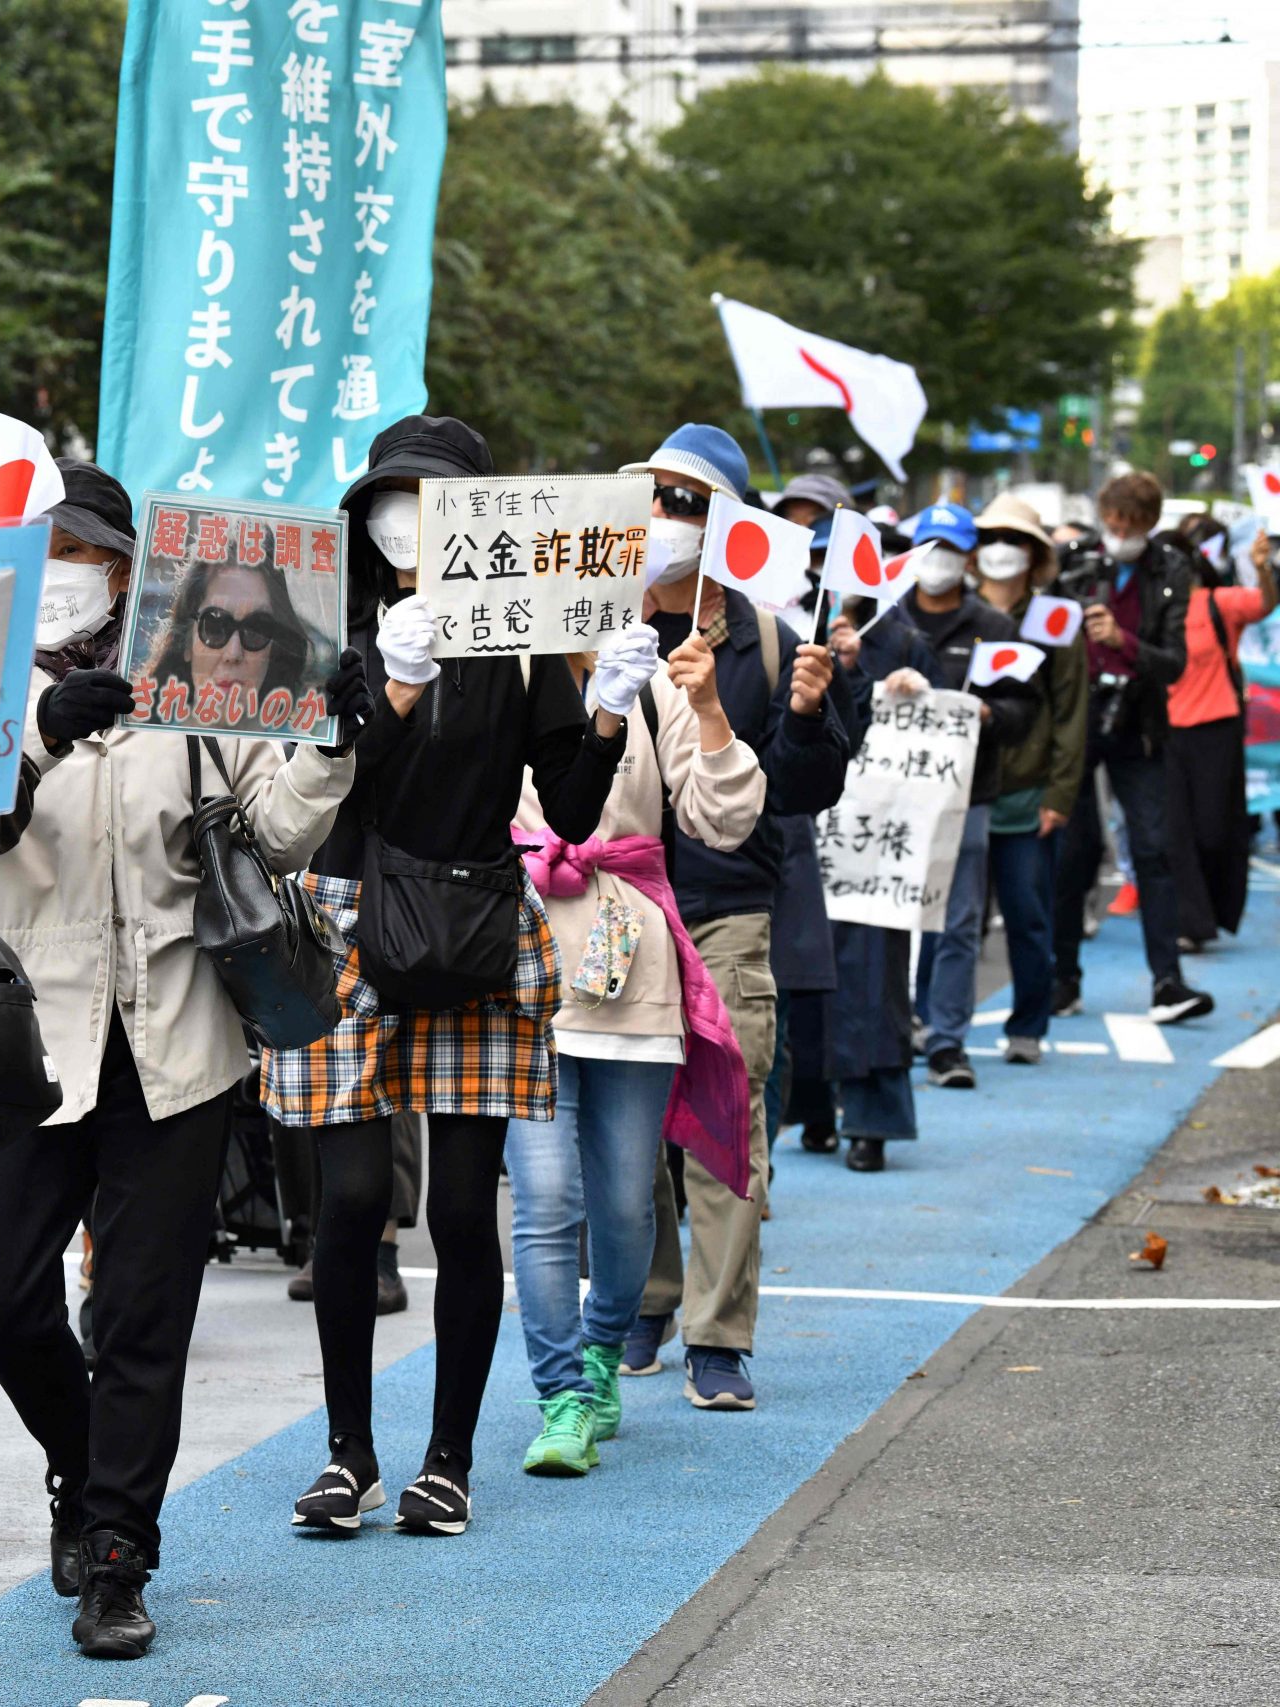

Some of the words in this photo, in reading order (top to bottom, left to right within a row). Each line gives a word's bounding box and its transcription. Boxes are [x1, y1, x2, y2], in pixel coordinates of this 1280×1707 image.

[332, 0, 420, 483] 室外交を通し
[436, 486, 559, 517] 小室佳代
[153, 509, 337, 573] 疑惑は調査
[441, 525, 647, 581] 公金詐欺罪
[437, 598, 534, 641] で告発
[132, 675, 327, 731] されないのか
